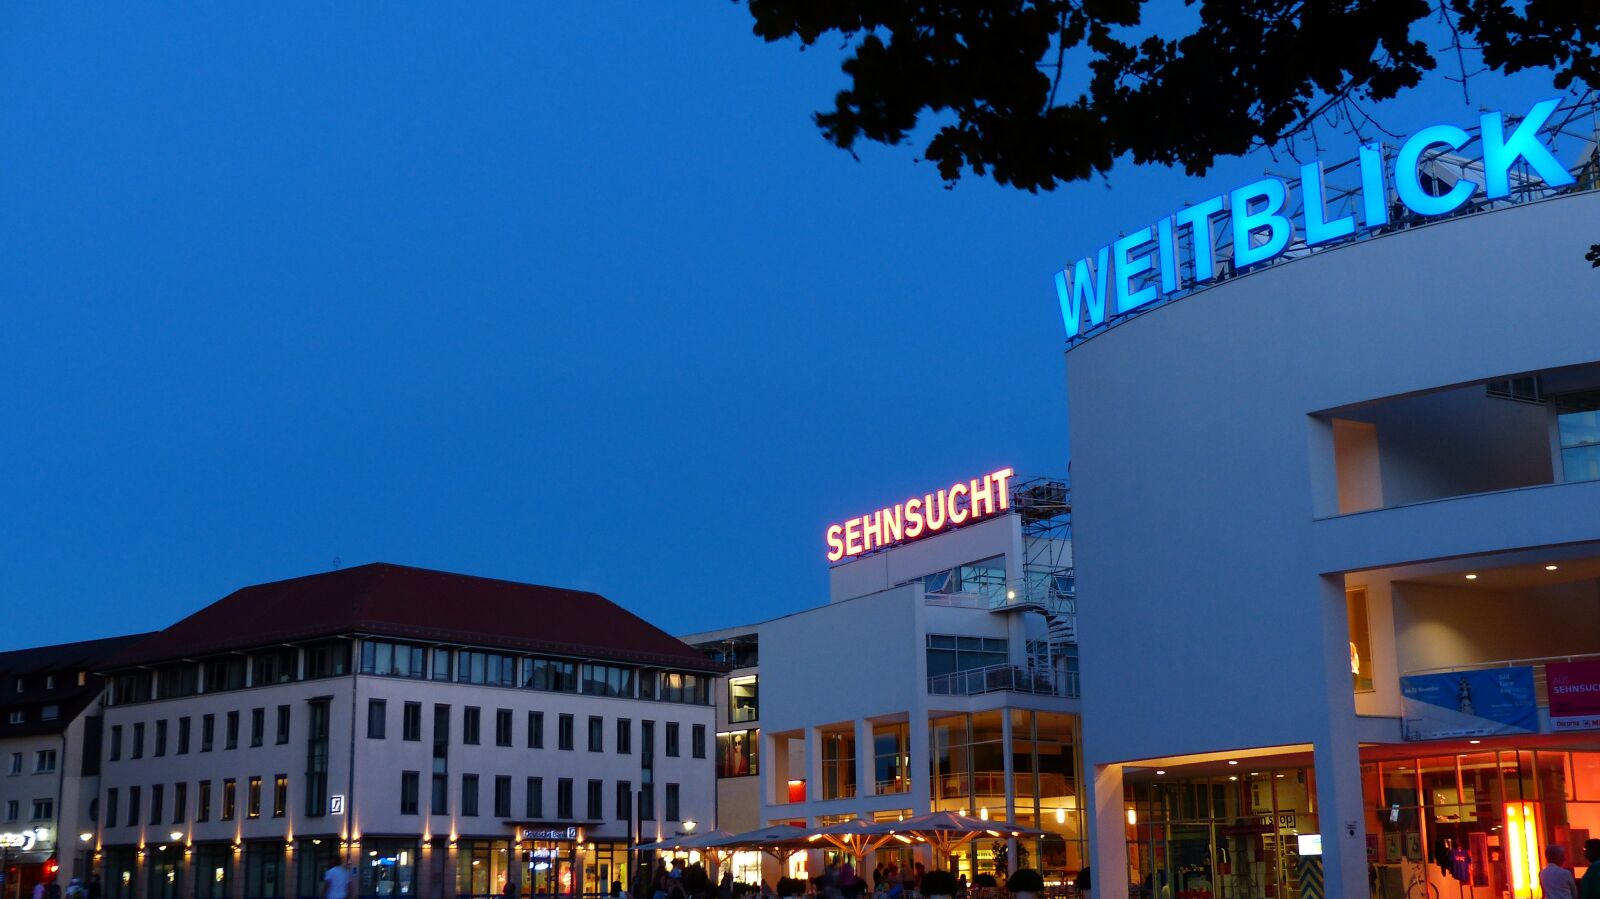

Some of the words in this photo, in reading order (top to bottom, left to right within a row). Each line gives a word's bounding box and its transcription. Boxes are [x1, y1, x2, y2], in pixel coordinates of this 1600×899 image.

[1055, 97, 1577, 339] WEITBLICK
[827, 468, 1014, 562] SEHNSUCHT
[1268, 815, 1293, 829] sop
